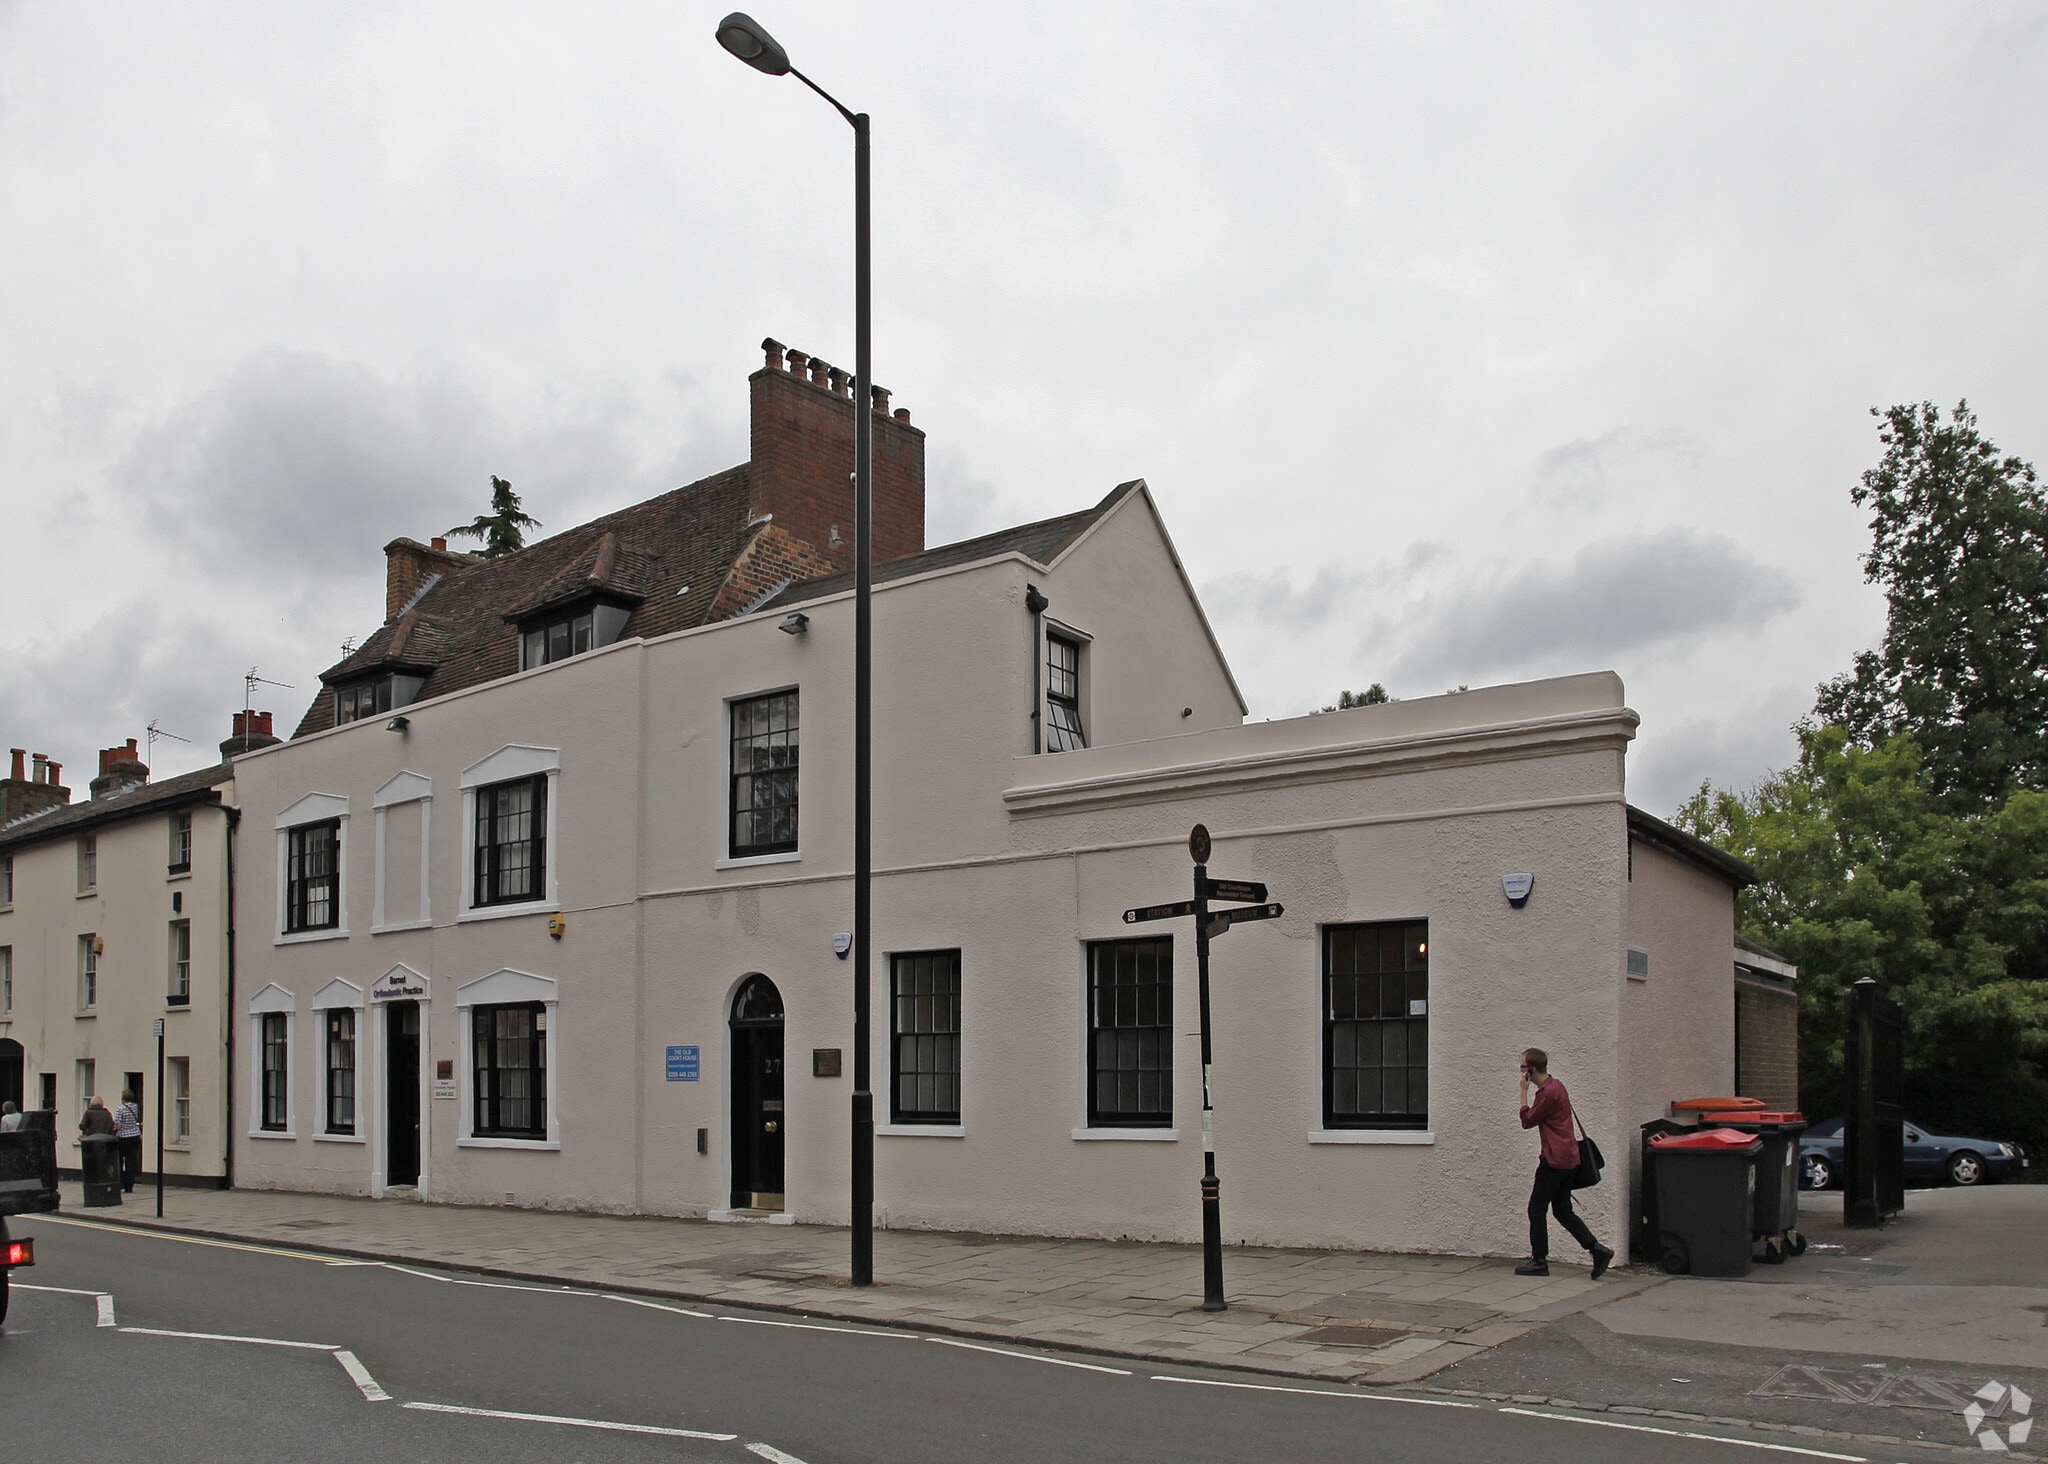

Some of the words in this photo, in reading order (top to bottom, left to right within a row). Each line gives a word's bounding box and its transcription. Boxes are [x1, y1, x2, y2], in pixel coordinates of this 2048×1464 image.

[1146, 907, 1172, 918] STATION
[1232, 908, 1258, 920] MUSEUM
[390, 976, 406, 984] Barnet
[374, 988, 402, 998] Orthodontic
[402, 986, 423, 994] Practice
[764, 1059, 780, 1074] 27
